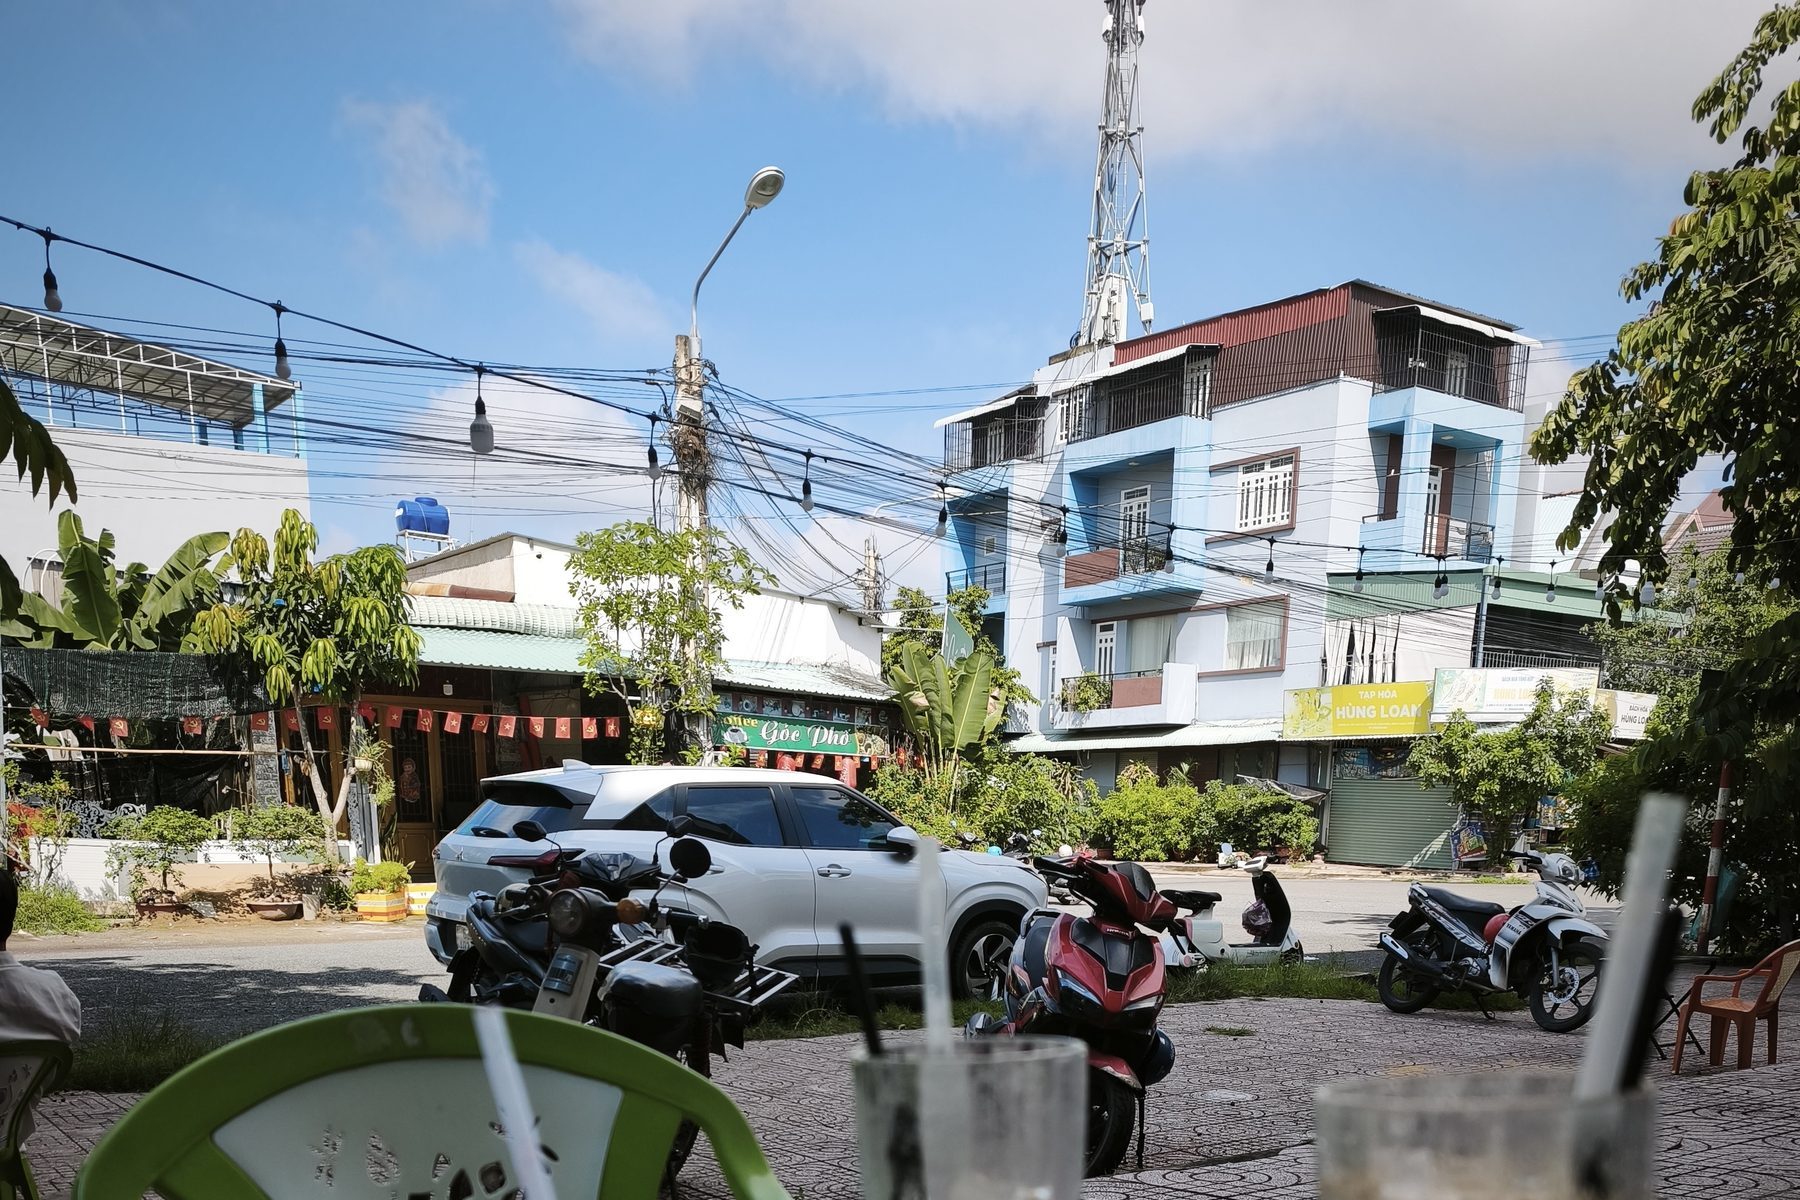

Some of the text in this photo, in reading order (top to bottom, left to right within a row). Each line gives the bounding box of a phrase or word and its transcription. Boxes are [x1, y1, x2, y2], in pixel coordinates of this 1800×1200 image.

[1336, 703, 1422, 720] HÙNG LOAN
[723, 715, 758, 727] offee
